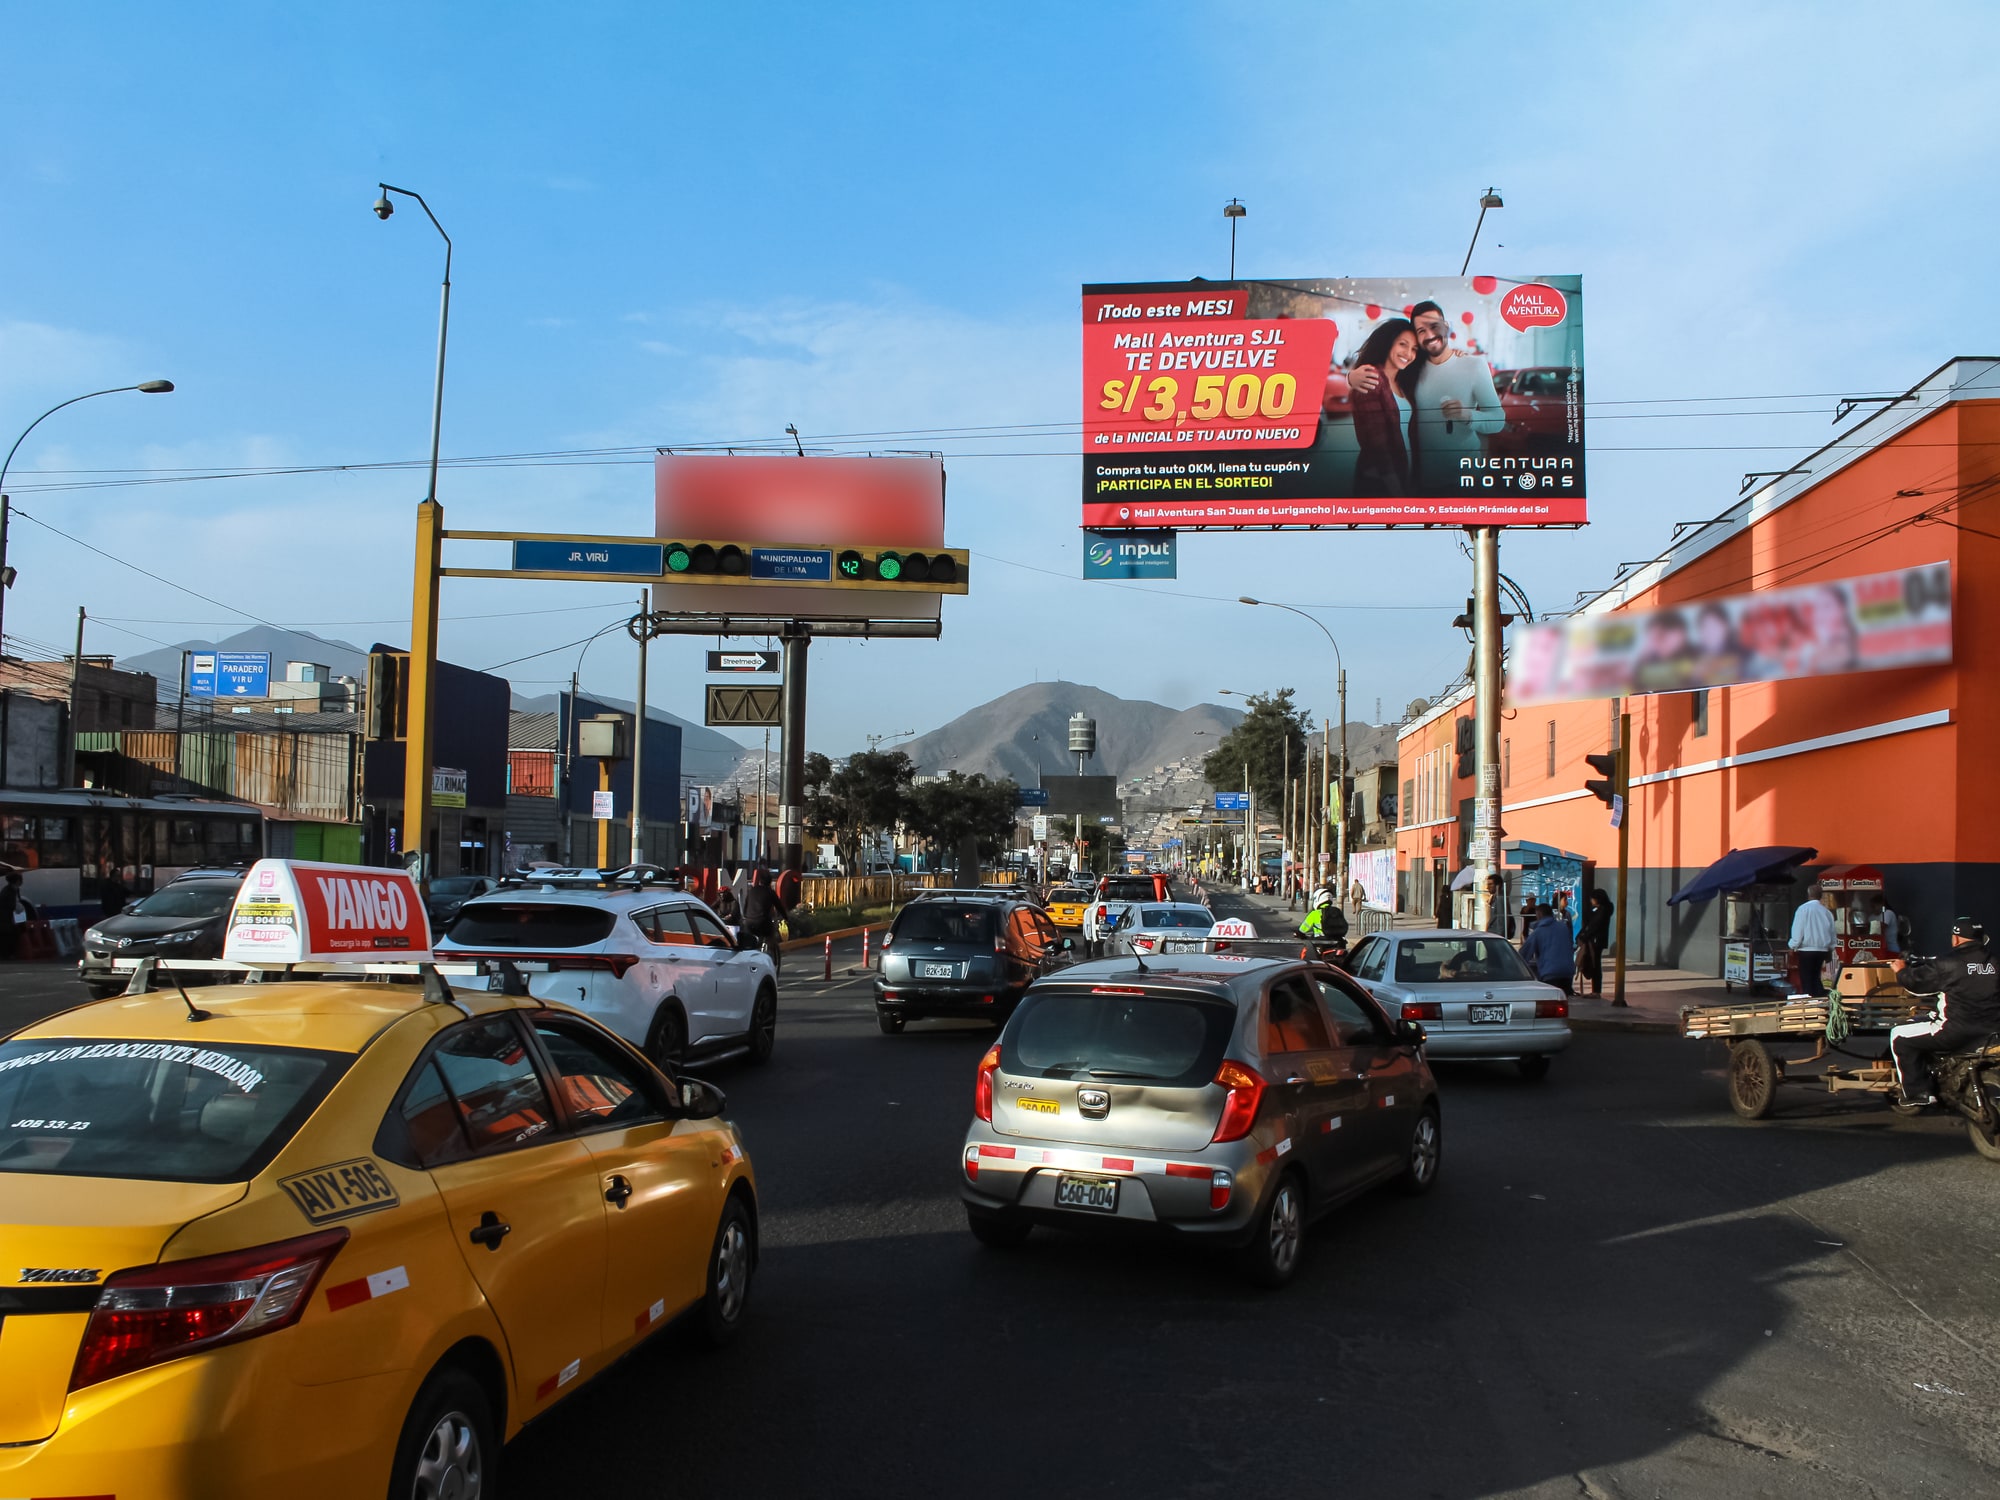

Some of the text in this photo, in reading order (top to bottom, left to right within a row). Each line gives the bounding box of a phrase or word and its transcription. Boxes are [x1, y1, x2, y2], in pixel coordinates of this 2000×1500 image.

[1513, 294, 1545, 305] MALL
[1097, 299, 1234, 322] ¡Todo este MES!
[1506, 305, 1560, 316] AVENTURA
[1114, 329, 1285, 349] Mall Aventura SJL
[1125, 349, 1278, 371] TE DEVUELVE
[1095, 428, 1300, 444] de la INICIAL DE TU AUTO NUEVO
[1096, 466, 1142, 477] Compra
[1143, 464, 1157, 475] tu
[1158, 464, 1186, 474] auto
[1218, 463, 1247, 473] llena
[1249, 462, 1262, 473] tu
[1264, 461, 1300, 475] cupón
[1302, 463, 1310, 473] y
[1460, 457, 1573, 469] AVENTURA
[1096, 477, 1273, 493] ¡PARTICIPA EN EL SORTEO!
[1134, 504, 1549, 518] Mall Aventura San Juan de Lurigancho Av. Lurigancho Cdra. 9, Estación Pirámide del Sol
[568, 549, 609, 563] JR. VIRÚ
[1119, 542, 1170, 558] input
[760, 554, 823, 564] MUNICIPALIDAD
[774, 566, 785, 574] DE
[842, 560, 859, 574] 42
[222, 665, 264, 673] PARADERO
[315, 876, 408, 931] YANGO
[235, 916, 293, 925] 986 904 140
[1216, 925, 1247, 936] TAXI
[1849, 940, 1880, 948] Canchitas
[1966, 962, 1996, 975] FILA
[48, 1045, 93, 1062] UN
[79, 1043, 197, 1065] ELOCUENTE
[191, 1048, 264, 1094] MEDIADOR
[11, 1119, 91, 1131] JOB 33: 23
[292, 1163, 392, 1214] AVY-505
